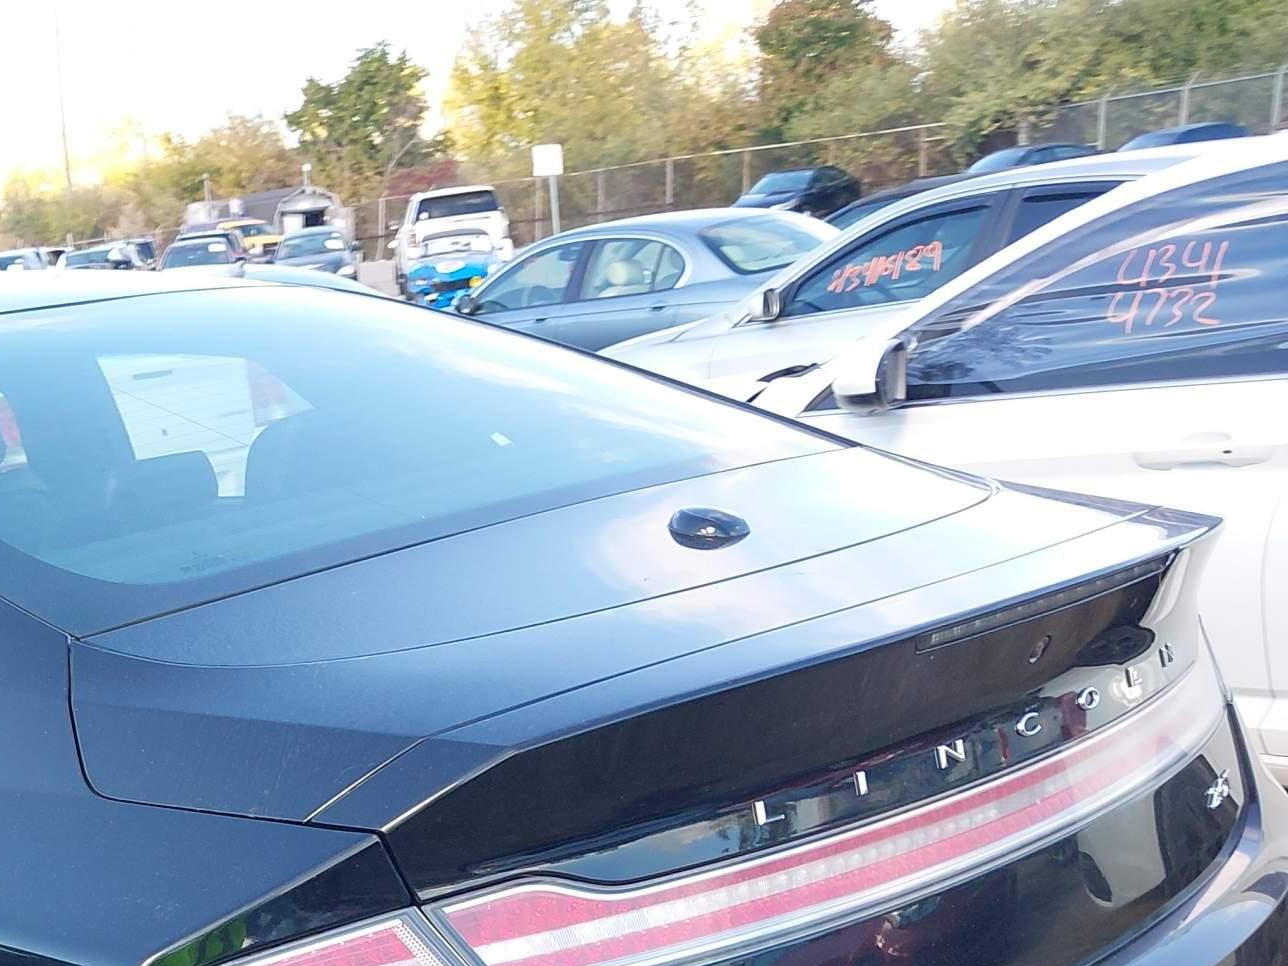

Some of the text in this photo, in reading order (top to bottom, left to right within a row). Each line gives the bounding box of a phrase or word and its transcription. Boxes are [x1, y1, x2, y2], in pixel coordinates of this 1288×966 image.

[1115, 240, 1230, 289] 4341
[1105, 286, 1221, 335] 4732
[752, 641, 1177, 827] LINCOLN
